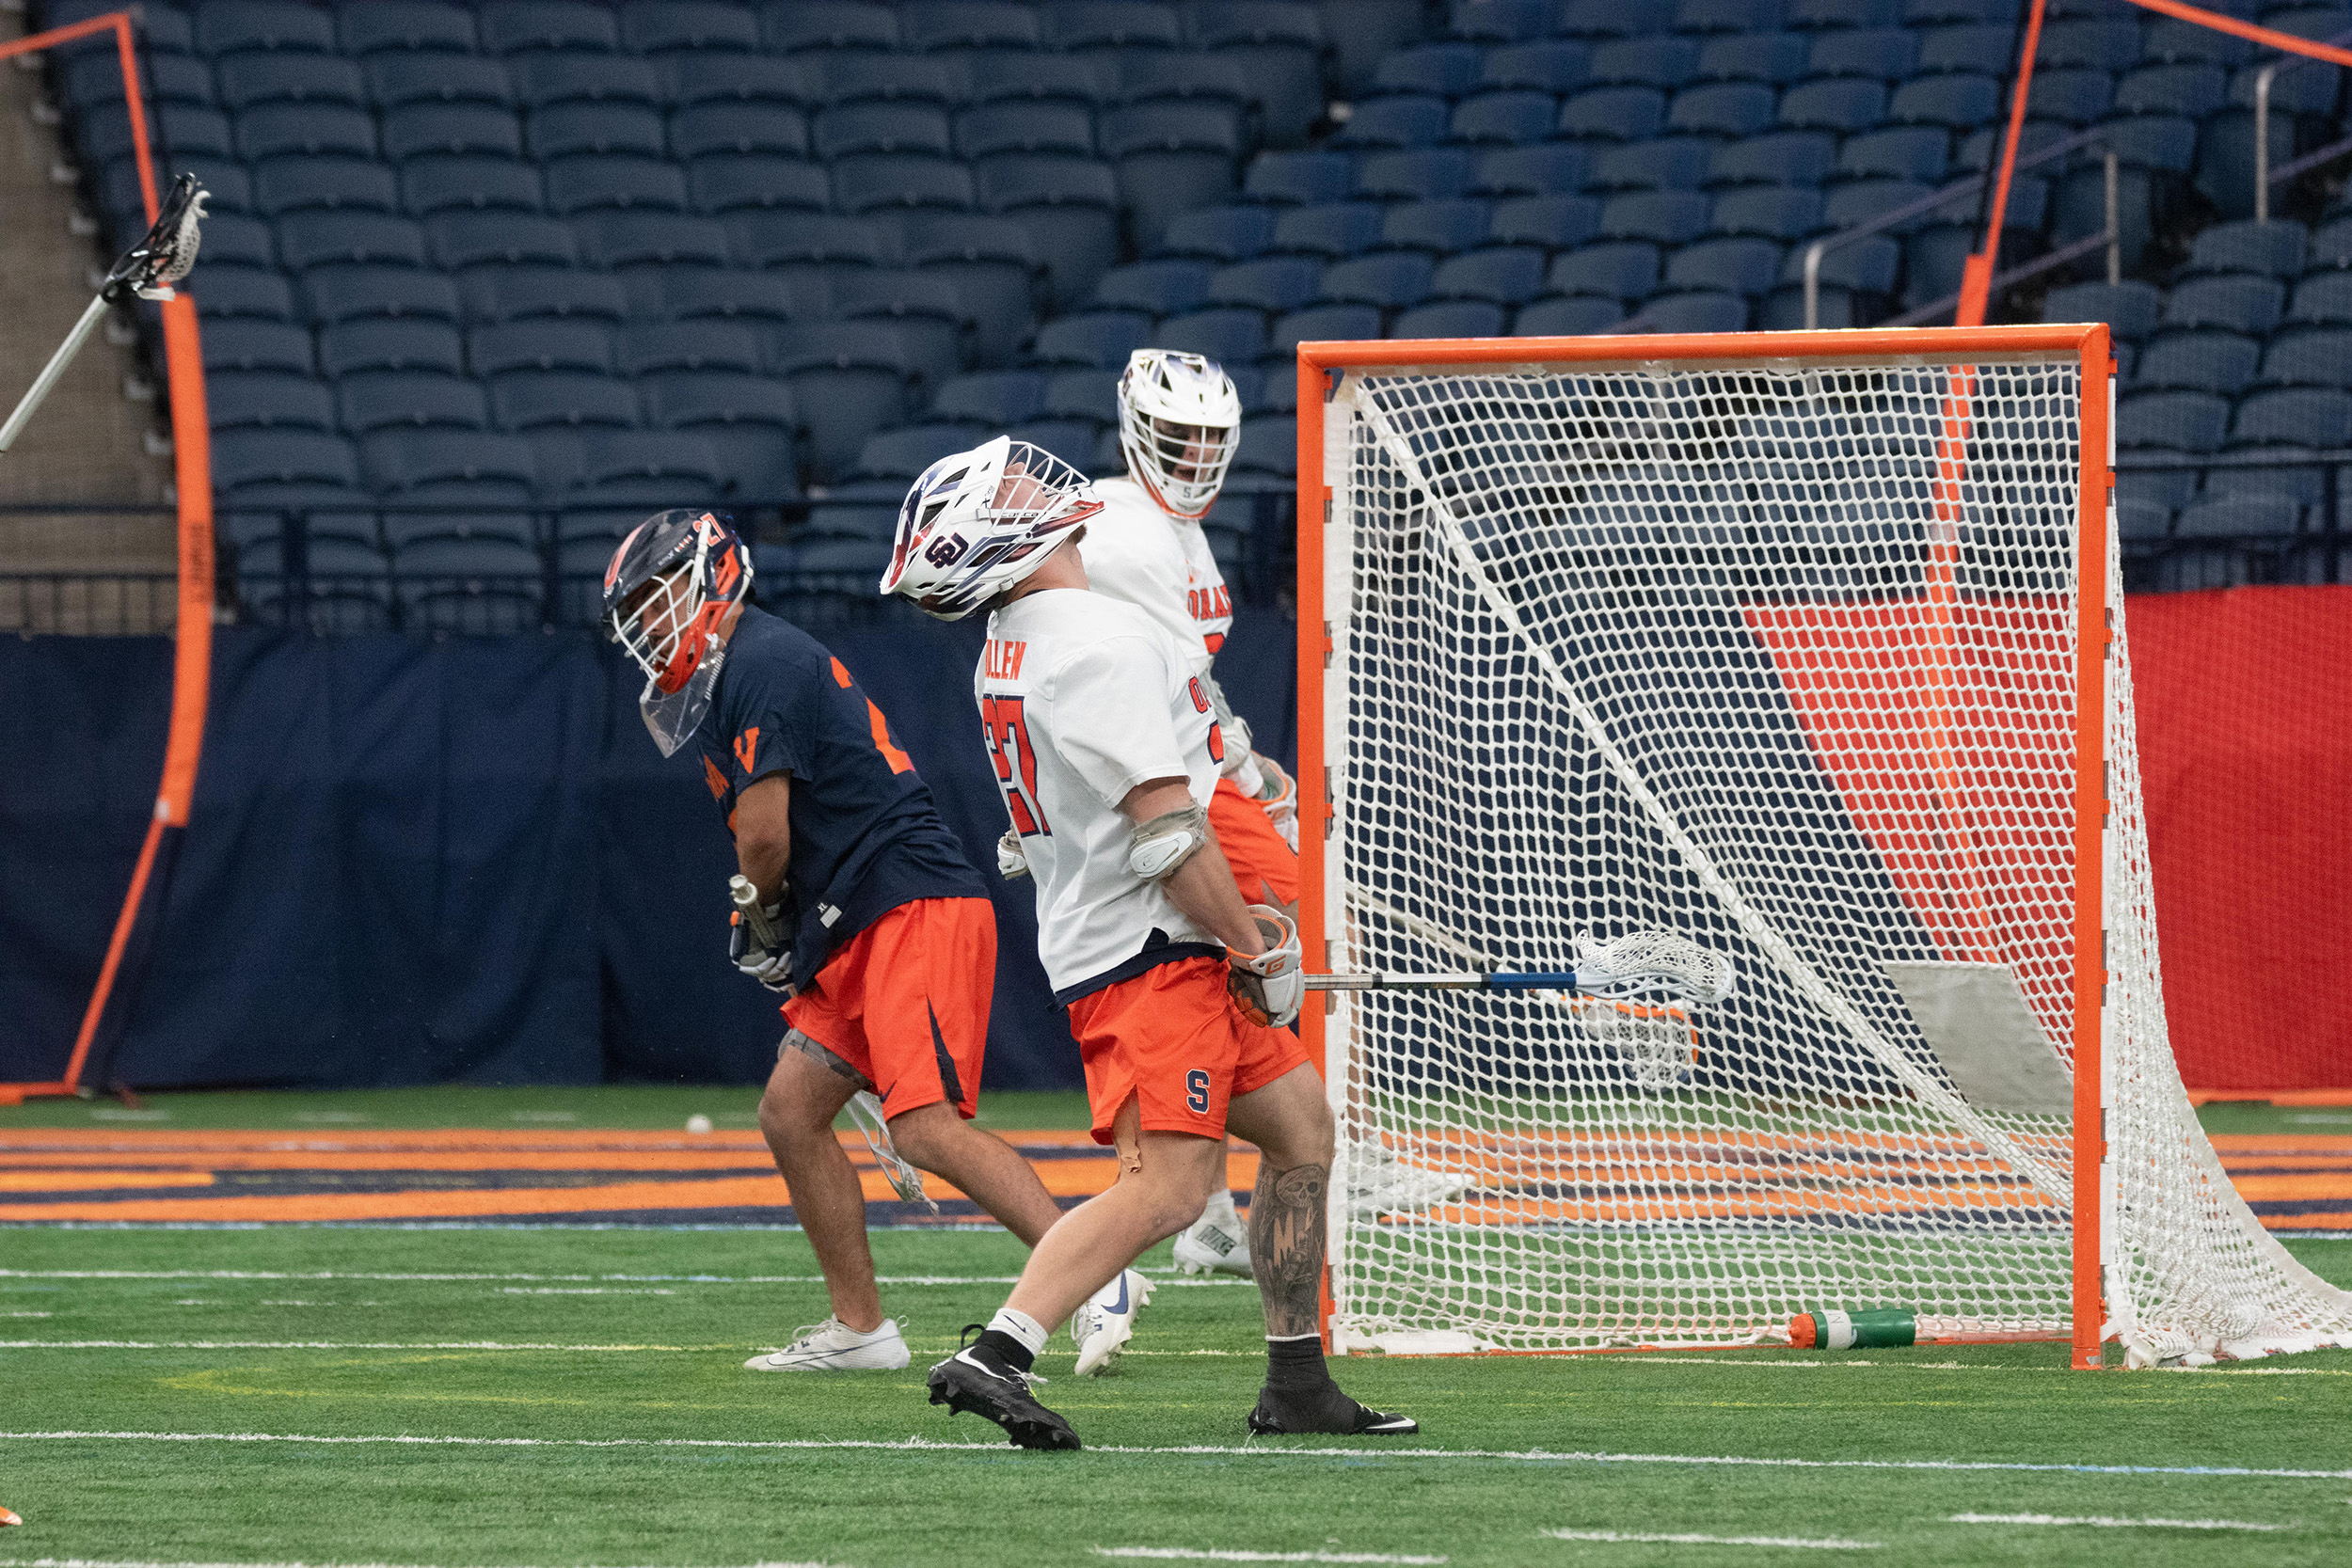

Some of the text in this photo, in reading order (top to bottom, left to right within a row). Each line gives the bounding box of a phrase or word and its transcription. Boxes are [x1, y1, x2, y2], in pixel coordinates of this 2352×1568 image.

[734, 726, 759, 774] V
[982, 692, 1053, 839] 27
[1185, 1069, 1211, 1115] S
